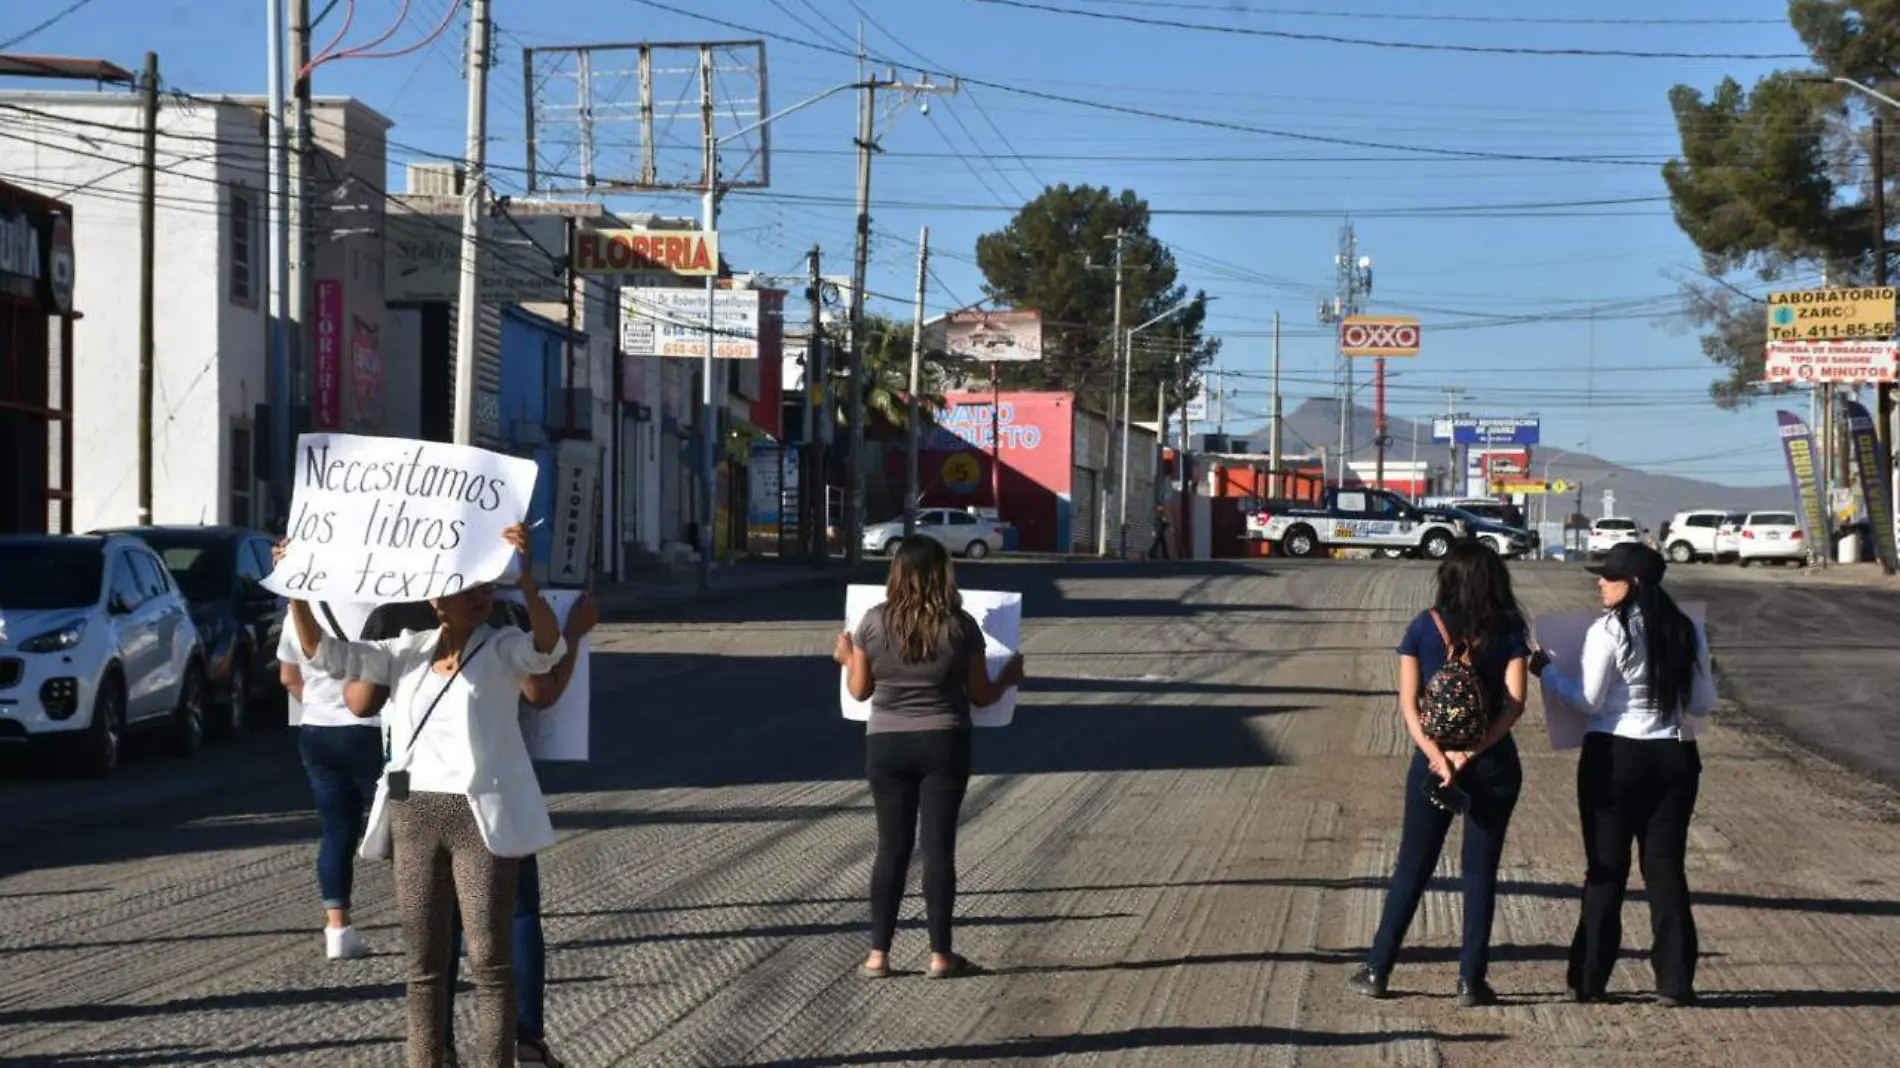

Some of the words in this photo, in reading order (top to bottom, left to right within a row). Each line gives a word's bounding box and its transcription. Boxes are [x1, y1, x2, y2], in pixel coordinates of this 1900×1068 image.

[577, 233, 713, 271] FLORERIA
[1767, 288, 1894, 305] LABORATORIO
[1798, 305, 1857, 319] ZARCO
[1346, 325, 1416, 348] OXXO
[1771, 326, 1801, 339] Tel.
[1808, 322, 1894, 337] 411-85-56
[318, 283, 334, 426] FLORERIA
[1771, 366, 1791, 376] EN
[1820, 366, 1889, 377] MINUTOS
[305, 444, 506, 512] Necesitamos
[290, 501, 335, 545] los
[364, 498, 465, 551] libros
[561, 466, 583, 575] FLORERIA
[285, 553, 327, 592] de
[354, 552, 465, 598] texto
